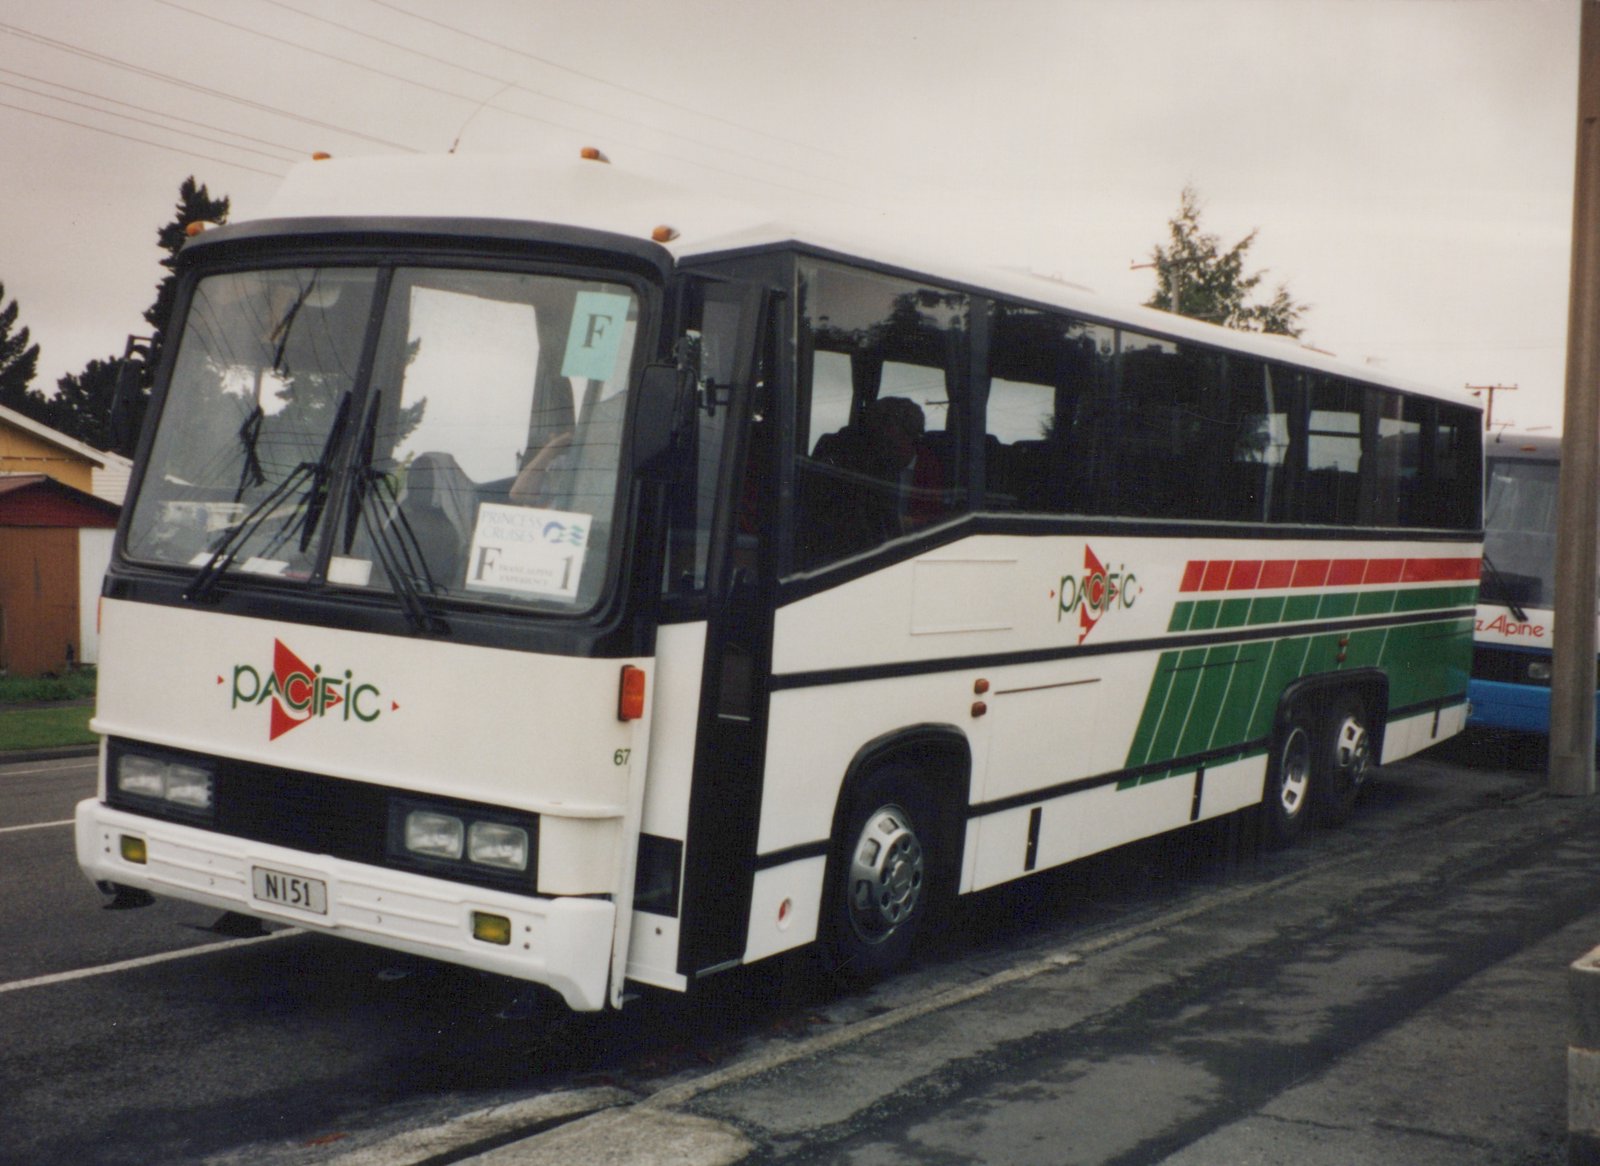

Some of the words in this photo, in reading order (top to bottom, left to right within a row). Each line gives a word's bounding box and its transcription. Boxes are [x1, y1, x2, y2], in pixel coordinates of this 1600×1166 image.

[581, 314, 613, 348] F
[479, 510, 543, 528] PRINCESS
[473, 546, 503, 581] F
[559, 554, 574, 591] 1
[1485, 614, 1544, 637] Alpine
[614, 748, 631, 766] 67
